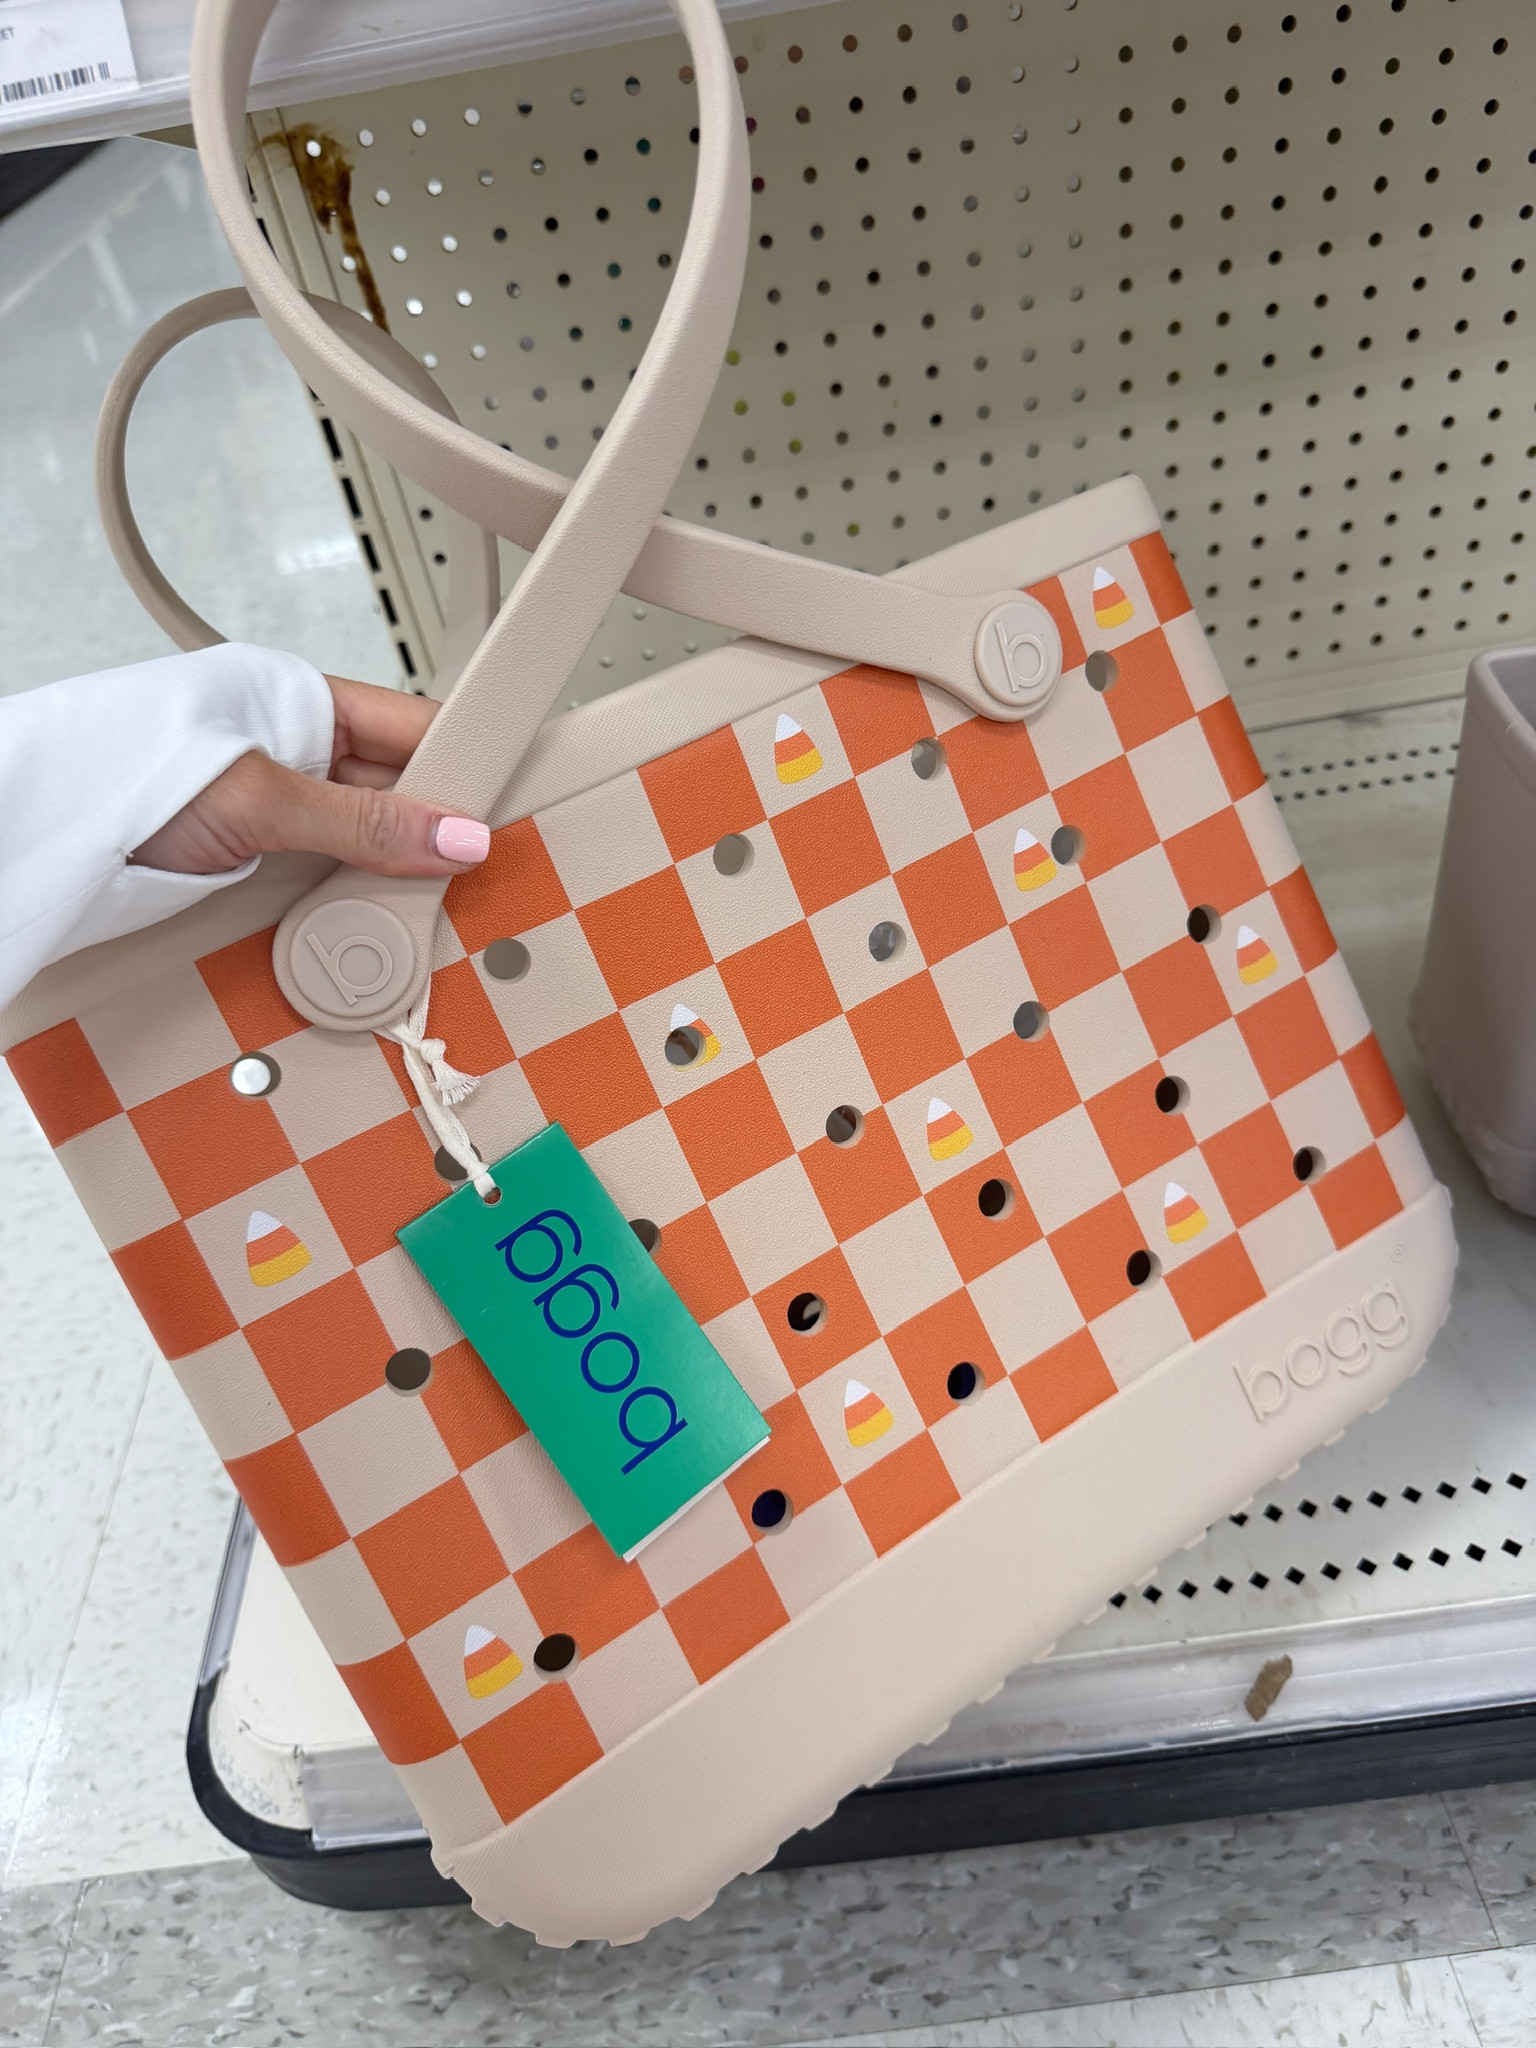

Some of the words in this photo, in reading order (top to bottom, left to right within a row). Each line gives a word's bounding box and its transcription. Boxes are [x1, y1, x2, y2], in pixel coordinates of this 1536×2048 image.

[994, 621, 1048, 693] b
[305, 932, 394, 1007] b
[495, 1209, 688, 1476] bogg
[1232, 1280, 1409, 1423] bogg
